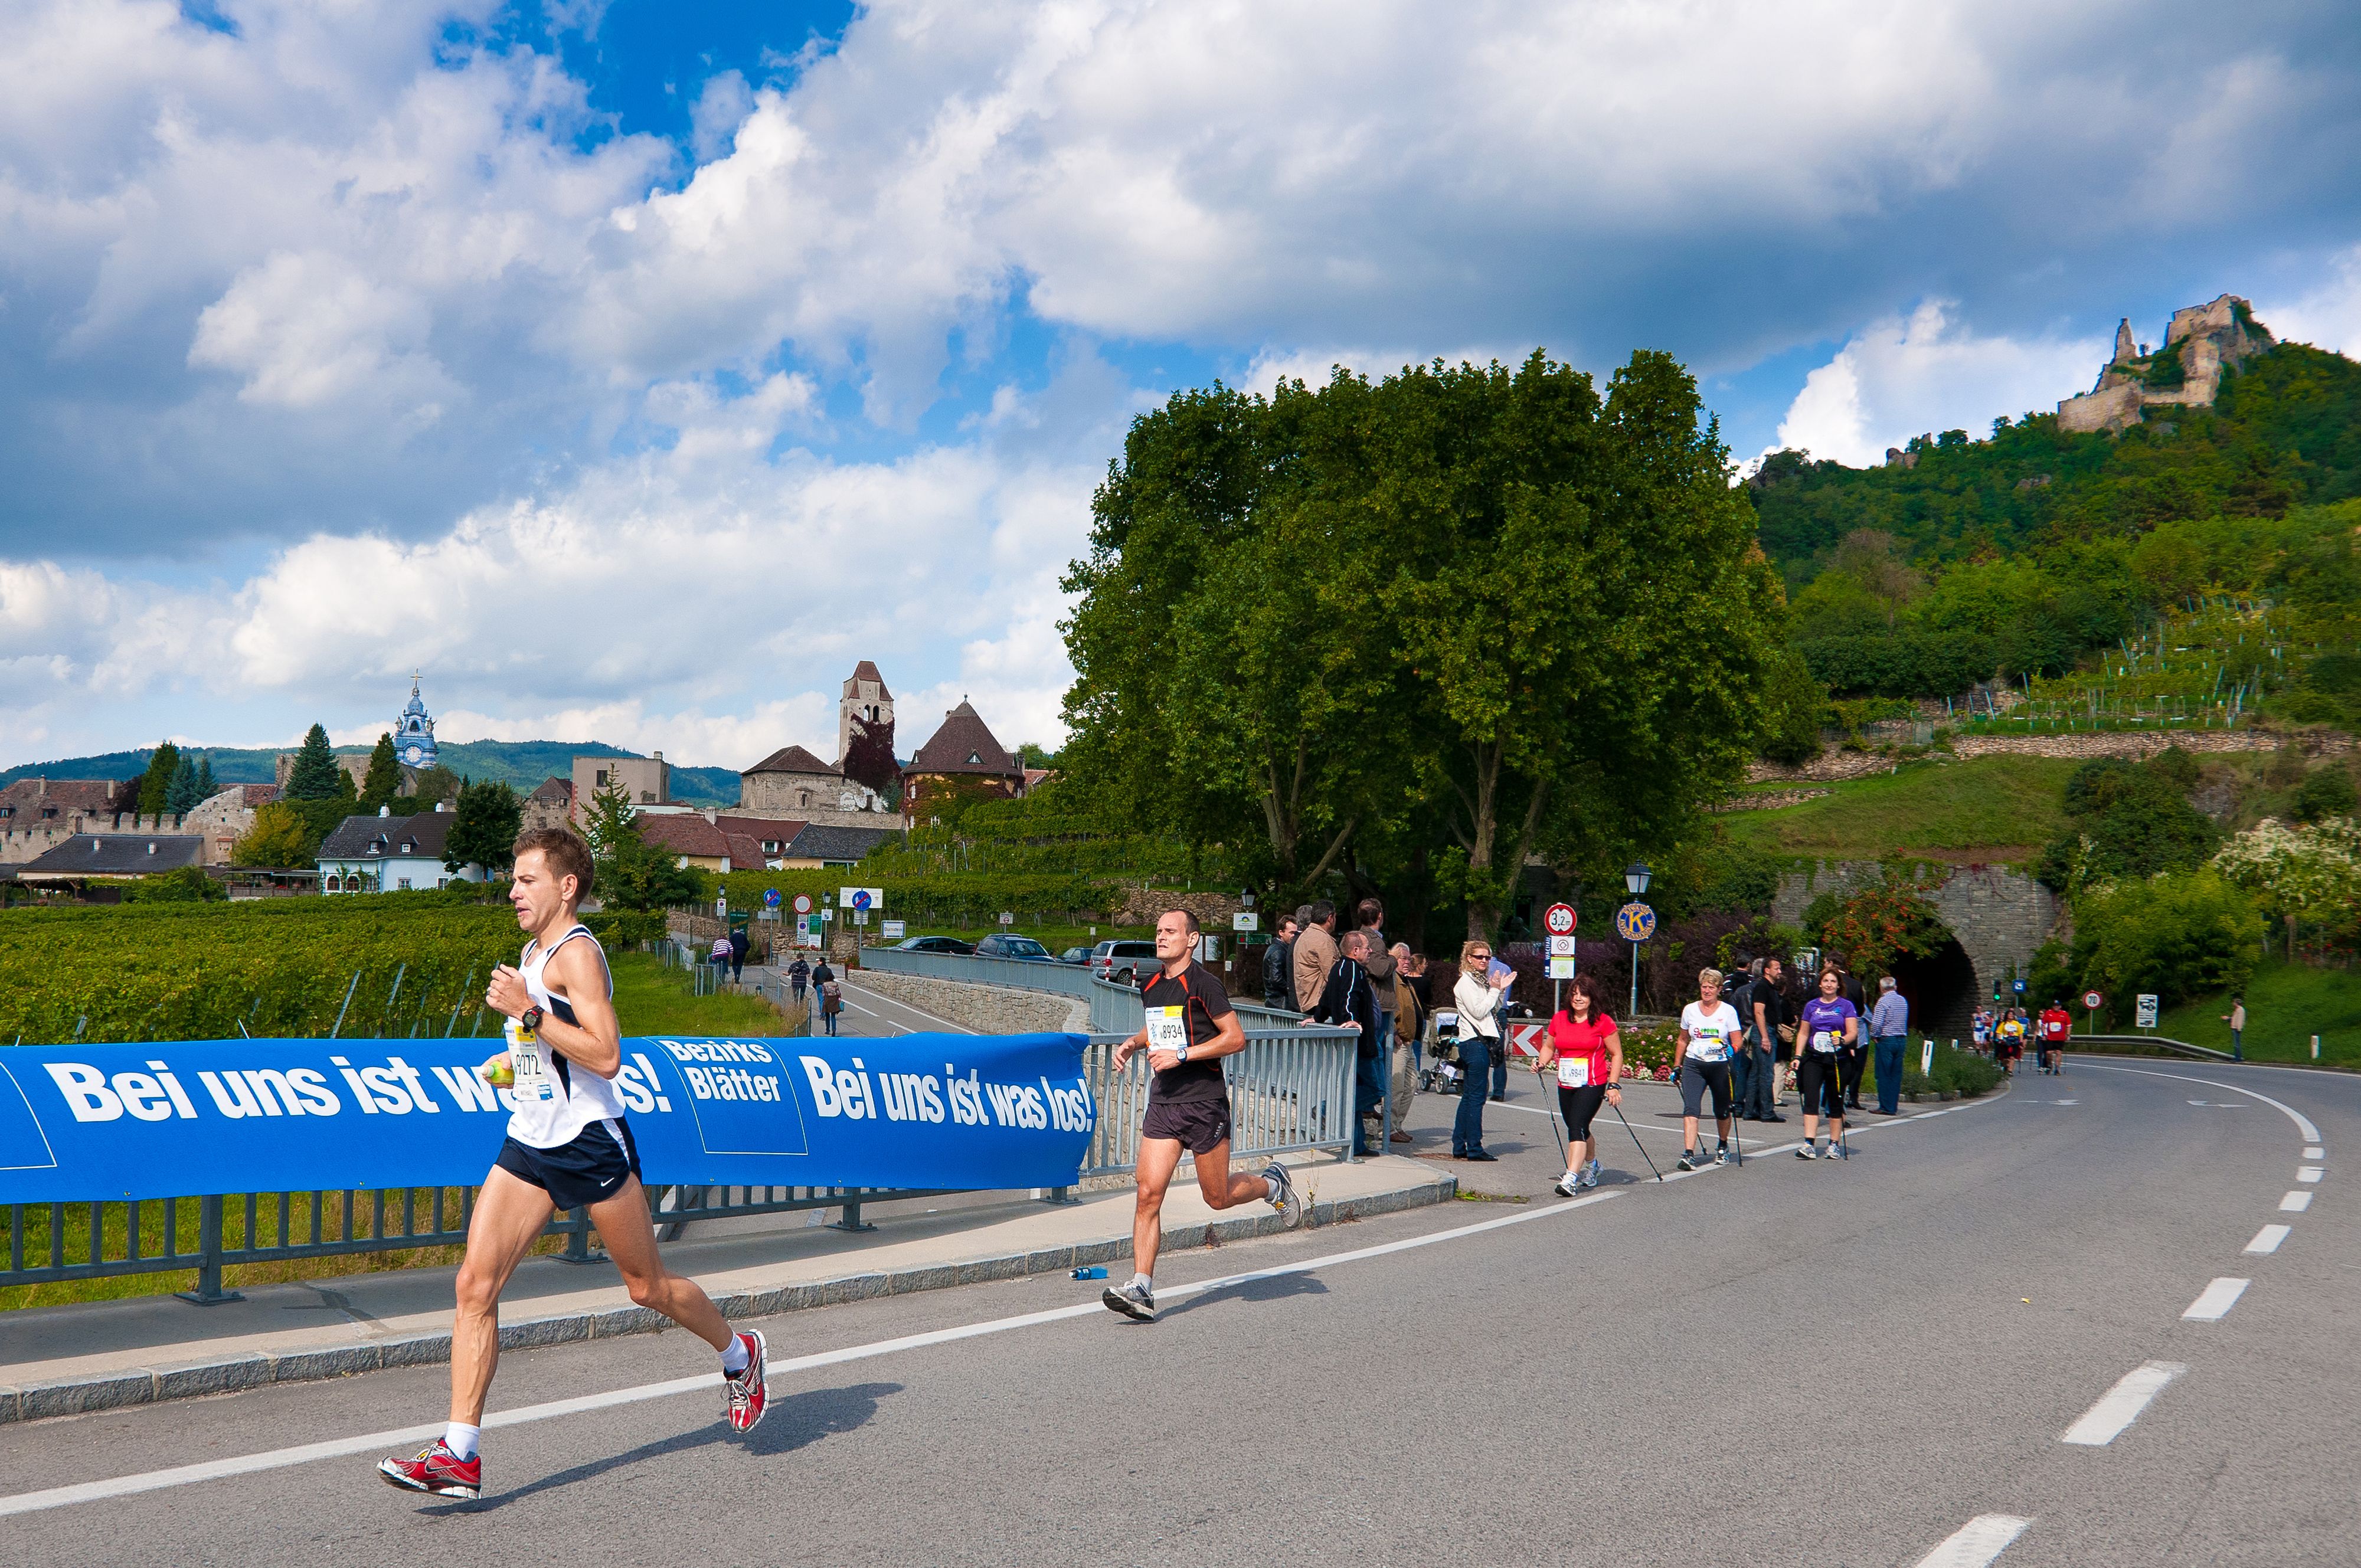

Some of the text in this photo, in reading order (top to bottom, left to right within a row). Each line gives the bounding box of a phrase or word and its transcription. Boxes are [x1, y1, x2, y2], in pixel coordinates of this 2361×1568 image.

[1630, 911, 1644, 932] K
[2088, 996, 2098, 1004] 70
[659, 1040, 772, 1063] Bezirks
[516, 1054, 542, 1075] 9272
[42, 1060, 198, 1122] Bei
[197, 1069, 341, 1119] uns
[329, 1056, 440, 1115] ist
[684, 1066, 781, 1102] Blätter
[799, 1056, 1092, 1132] Bei uns ist was los!
